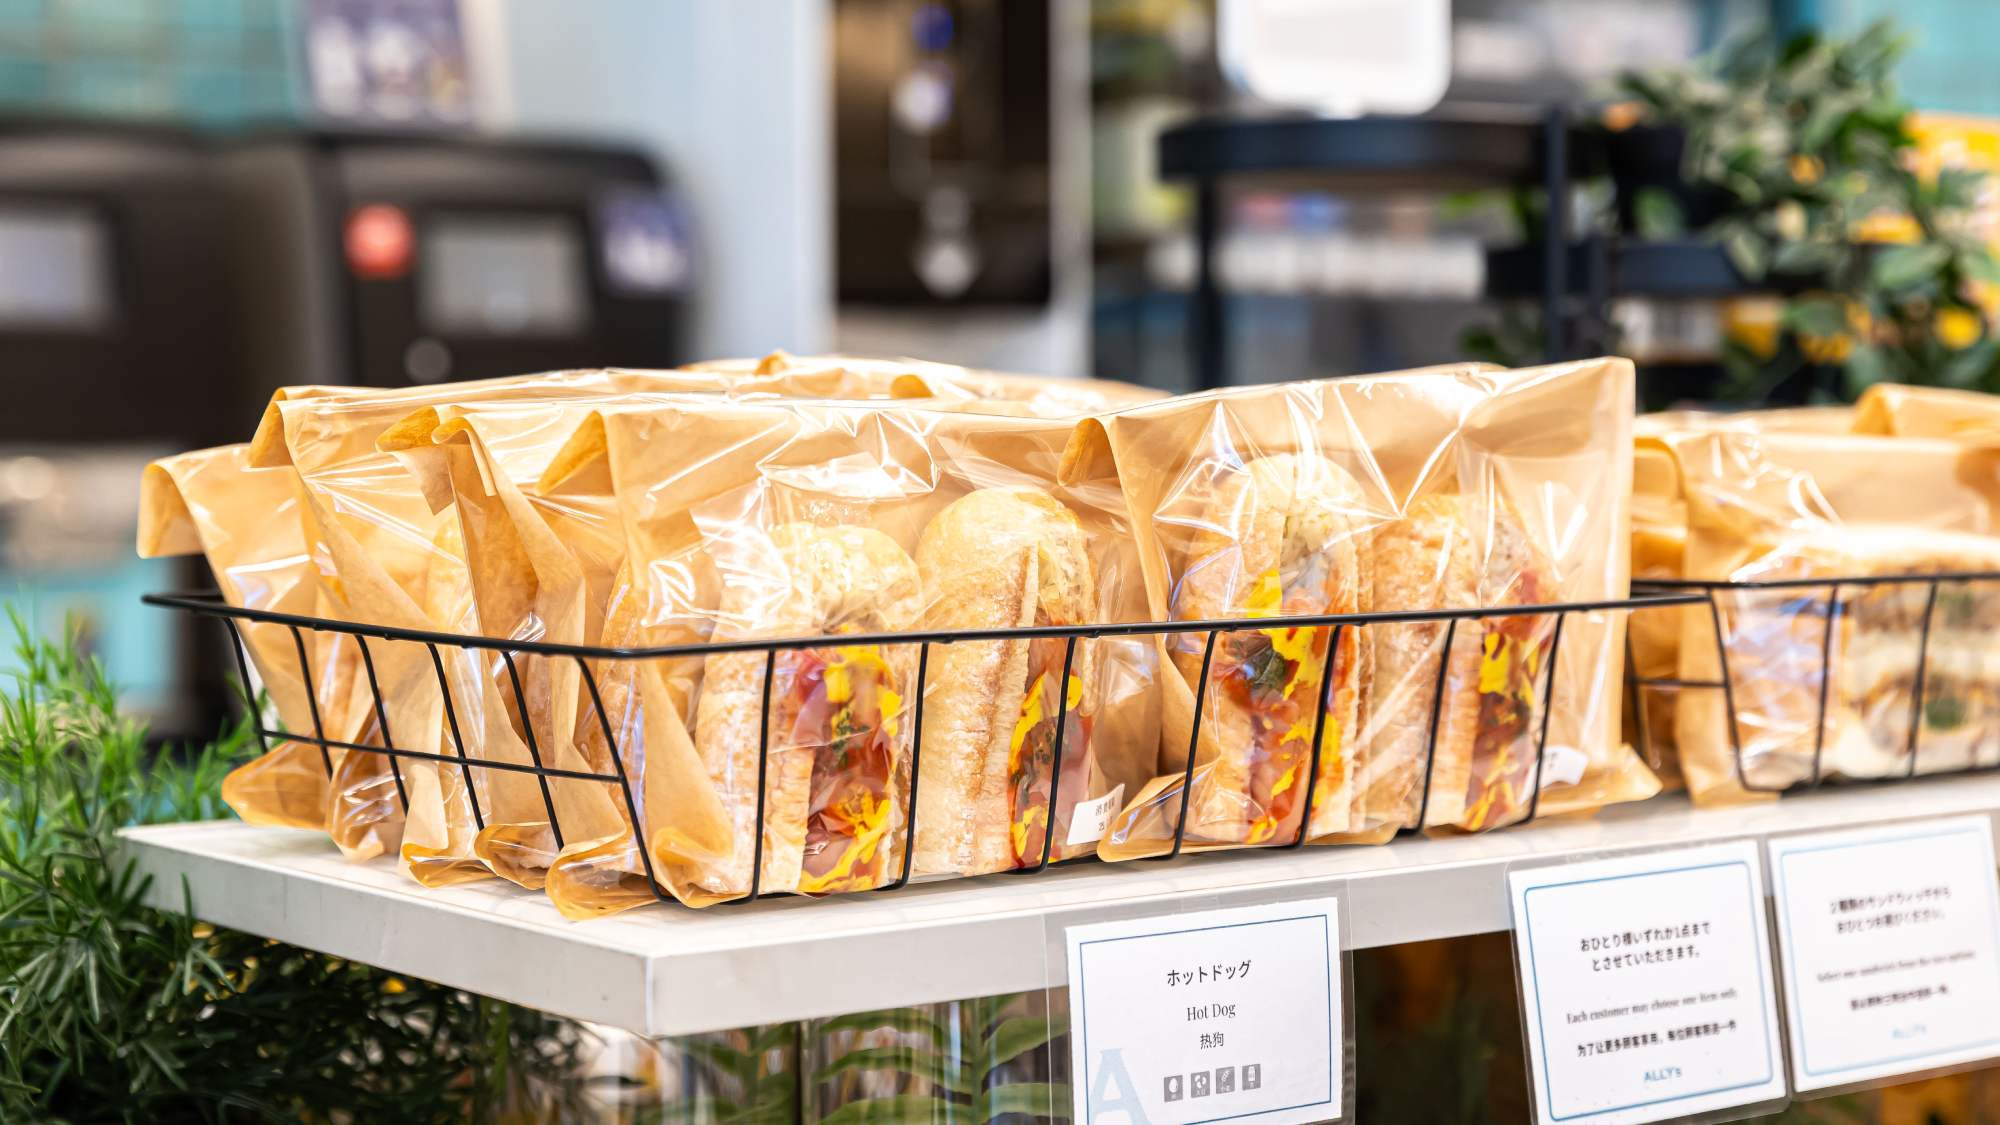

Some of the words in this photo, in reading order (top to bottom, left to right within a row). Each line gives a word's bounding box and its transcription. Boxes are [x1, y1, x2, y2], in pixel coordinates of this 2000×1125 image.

[1167, 959, 1252, 987] ホットドッグ
[1187, 1005, 1208, 1021] Hot
[1212, 1003, 1236, 1019] Dog
[1566, 1011, 1588, 1025] Each
[1200, 1031, 1224, 1050] 热狗
